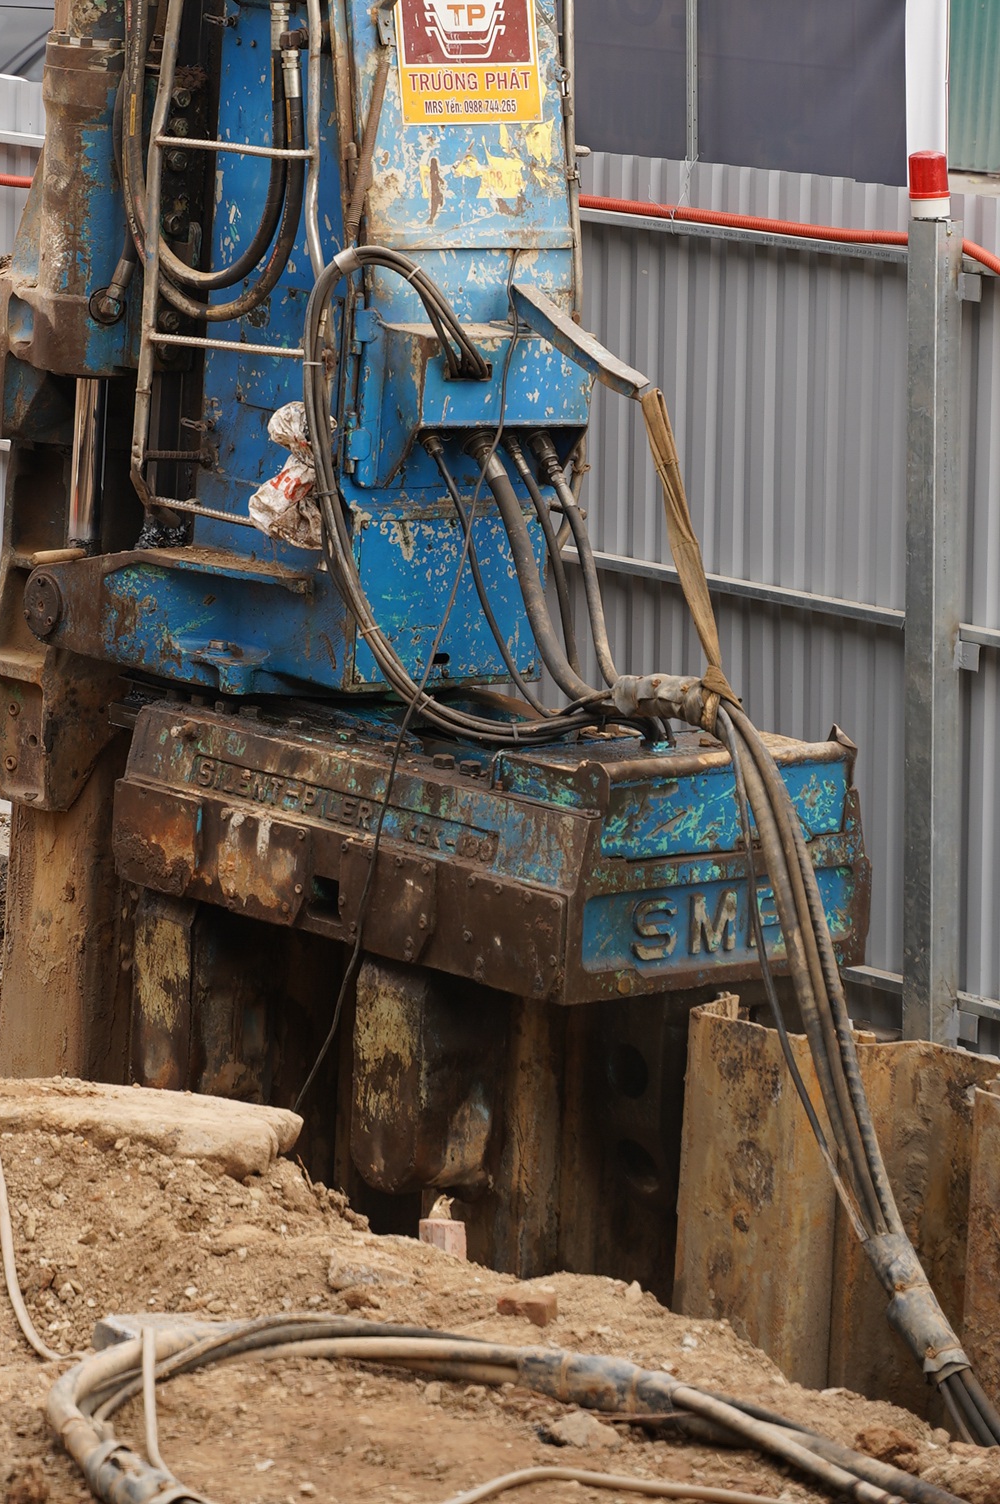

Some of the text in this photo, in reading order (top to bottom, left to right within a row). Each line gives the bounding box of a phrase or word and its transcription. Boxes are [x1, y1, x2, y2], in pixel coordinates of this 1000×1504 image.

[447, 4, 486, 26] TP
[409, 68, 531, 91] TRƯỜNG PHÁT
[425, 100, 443, 114] MRS
[464, 99, 517, 113] 0988.744.265
